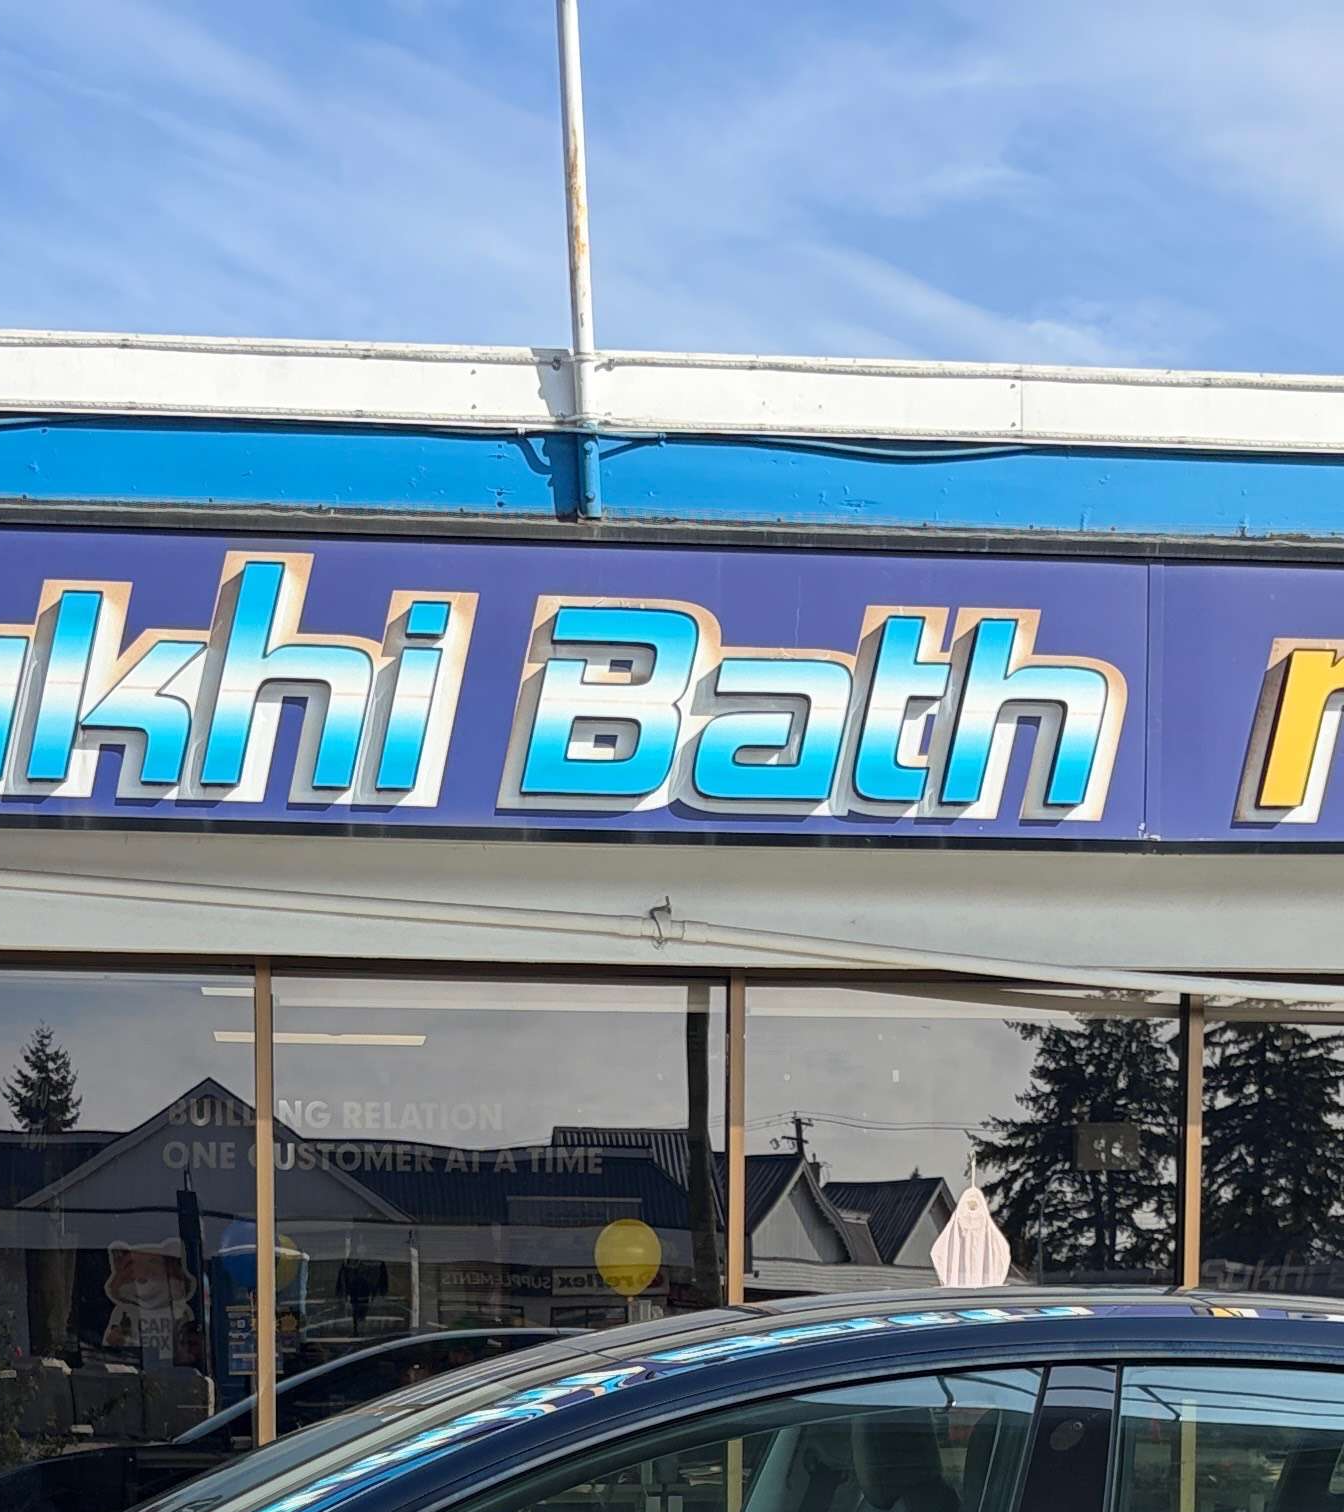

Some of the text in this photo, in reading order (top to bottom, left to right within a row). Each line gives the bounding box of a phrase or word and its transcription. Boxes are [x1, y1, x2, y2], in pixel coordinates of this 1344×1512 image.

[497, 594, 1125, 823] Bath
[168, 1098, 504, 1132] BUILNG RELATION
[162, 1140, 236, 1169] ONE
[493, 1148, 518, 1174] A
[528, 1147, 603, 1175] TIME
